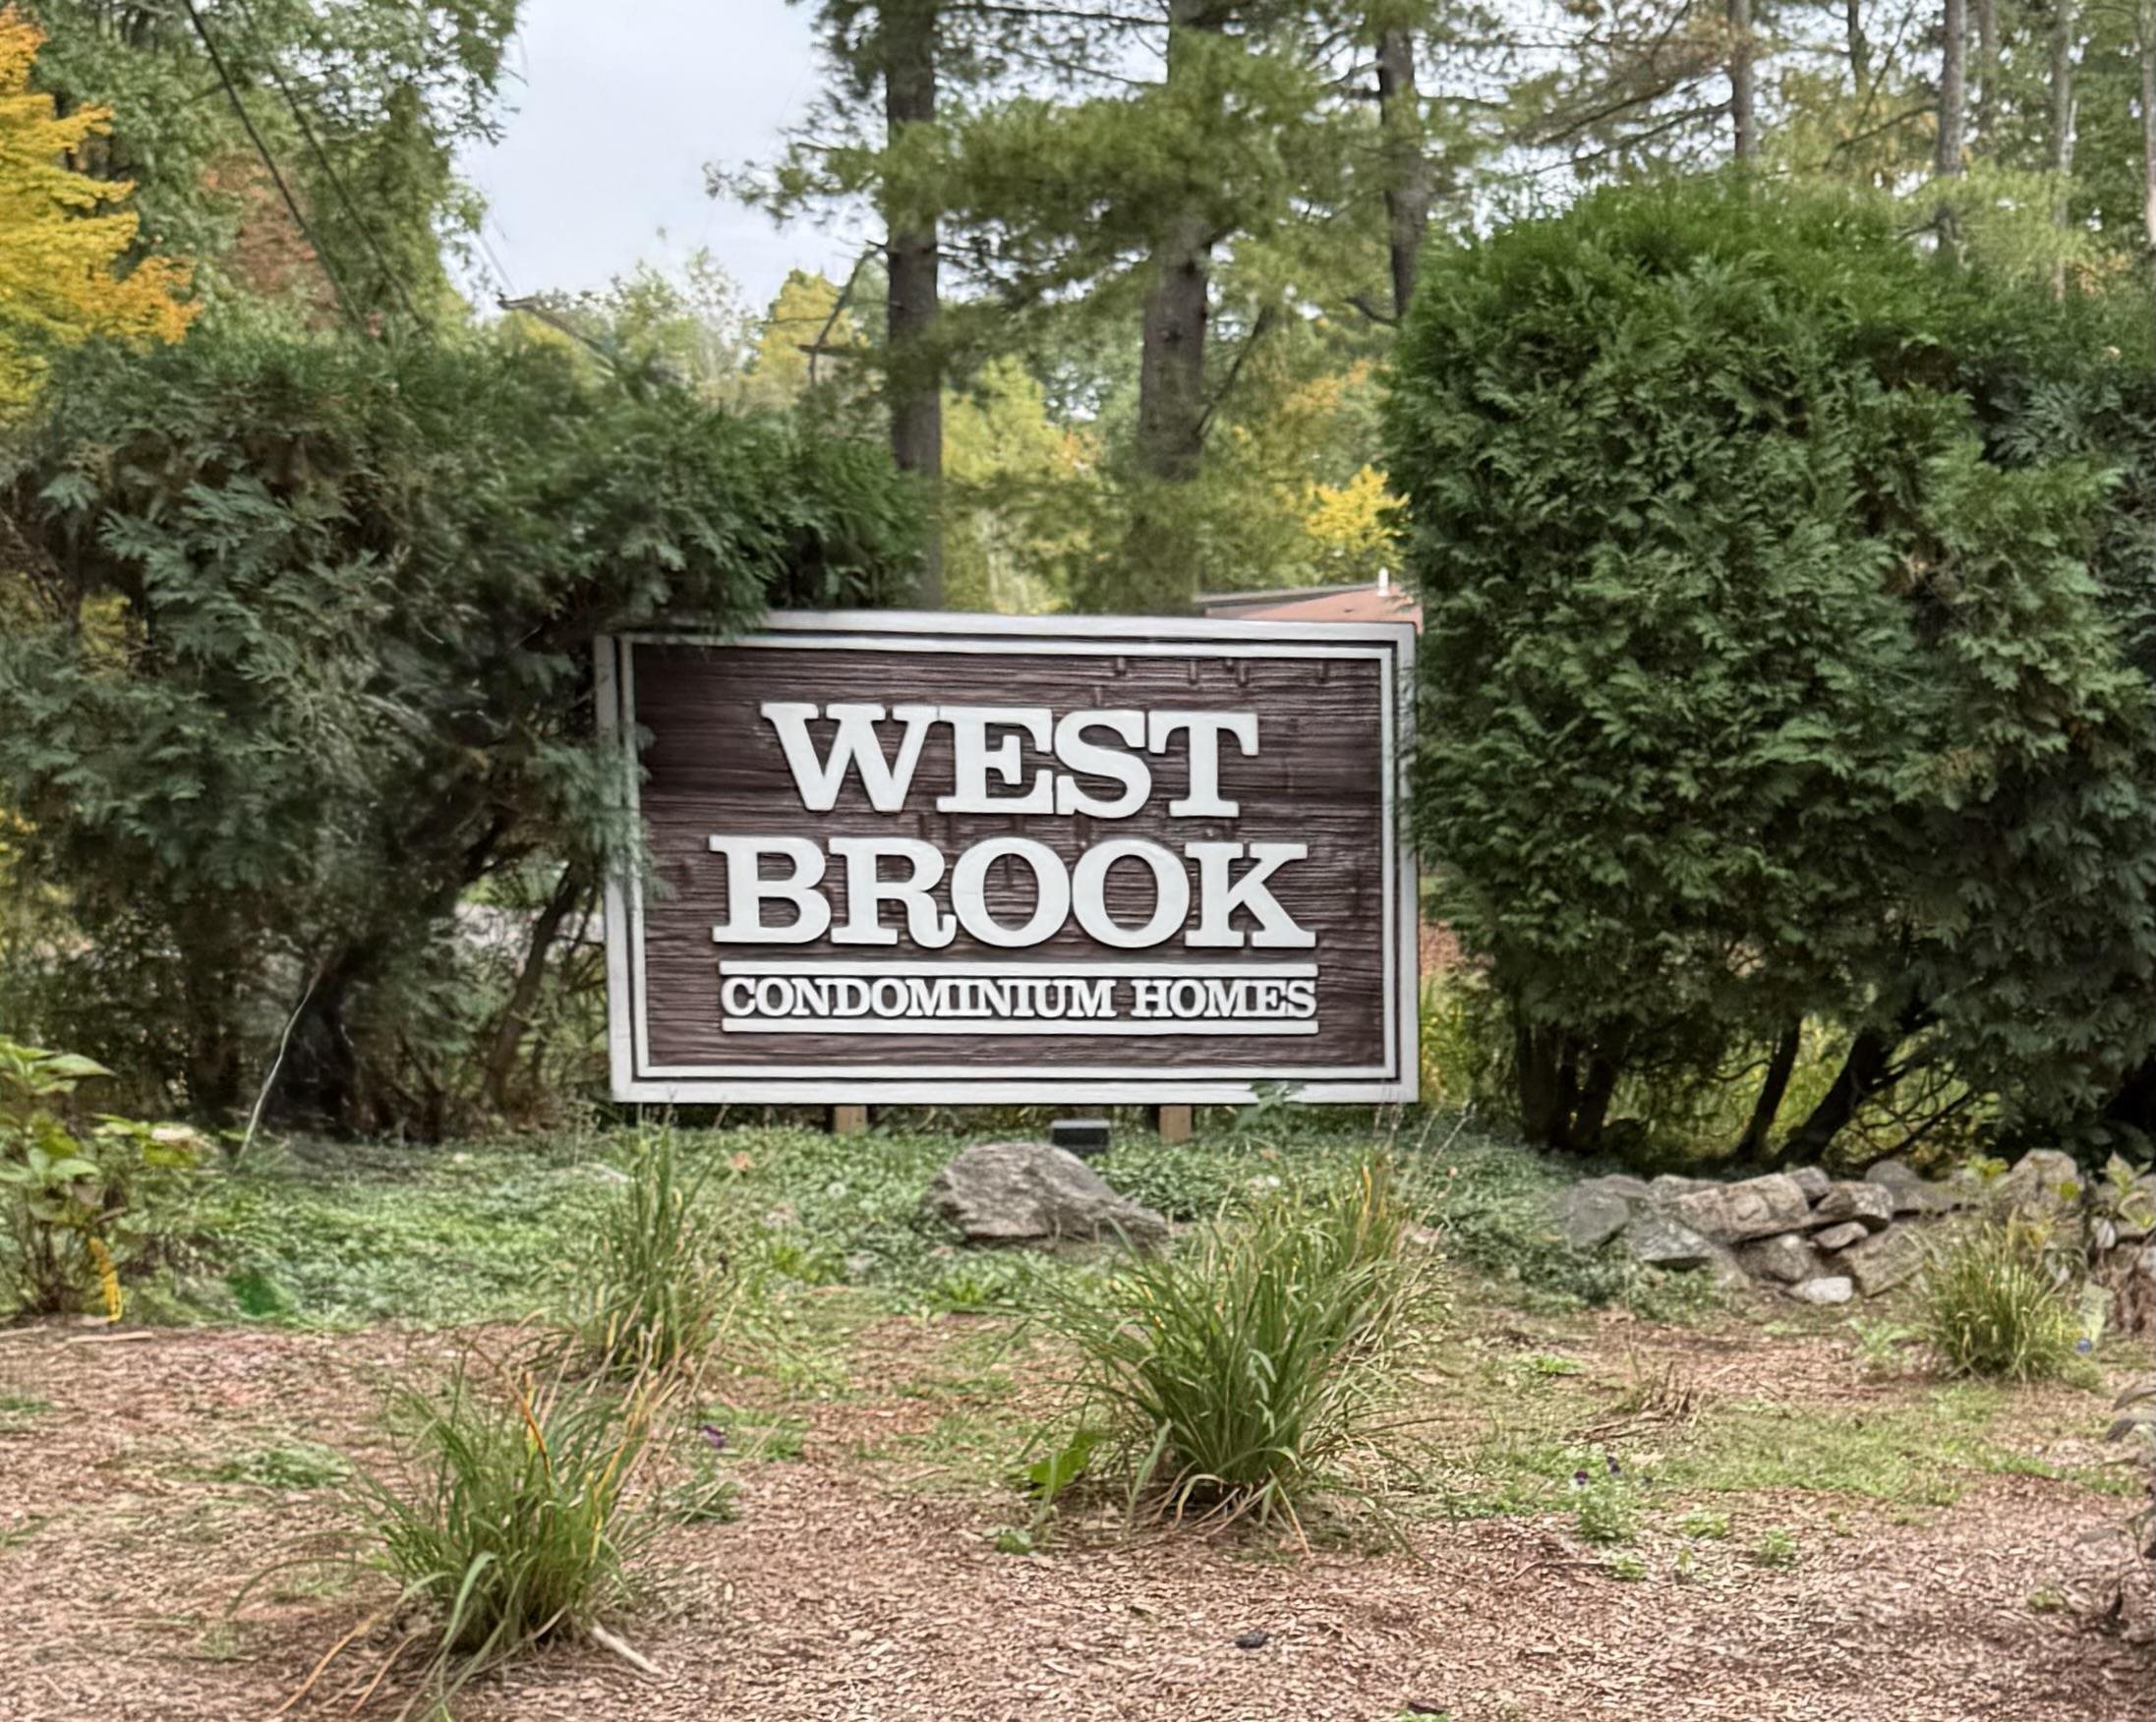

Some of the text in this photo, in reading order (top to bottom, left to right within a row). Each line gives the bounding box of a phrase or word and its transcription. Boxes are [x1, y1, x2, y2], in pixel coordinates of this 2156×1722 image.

[760, 701, 1259, 818] WEST
[709, 835, 1317, 948] BROOK
[721, 978, 1317, 1018] CONDOMINIUM HOMES
